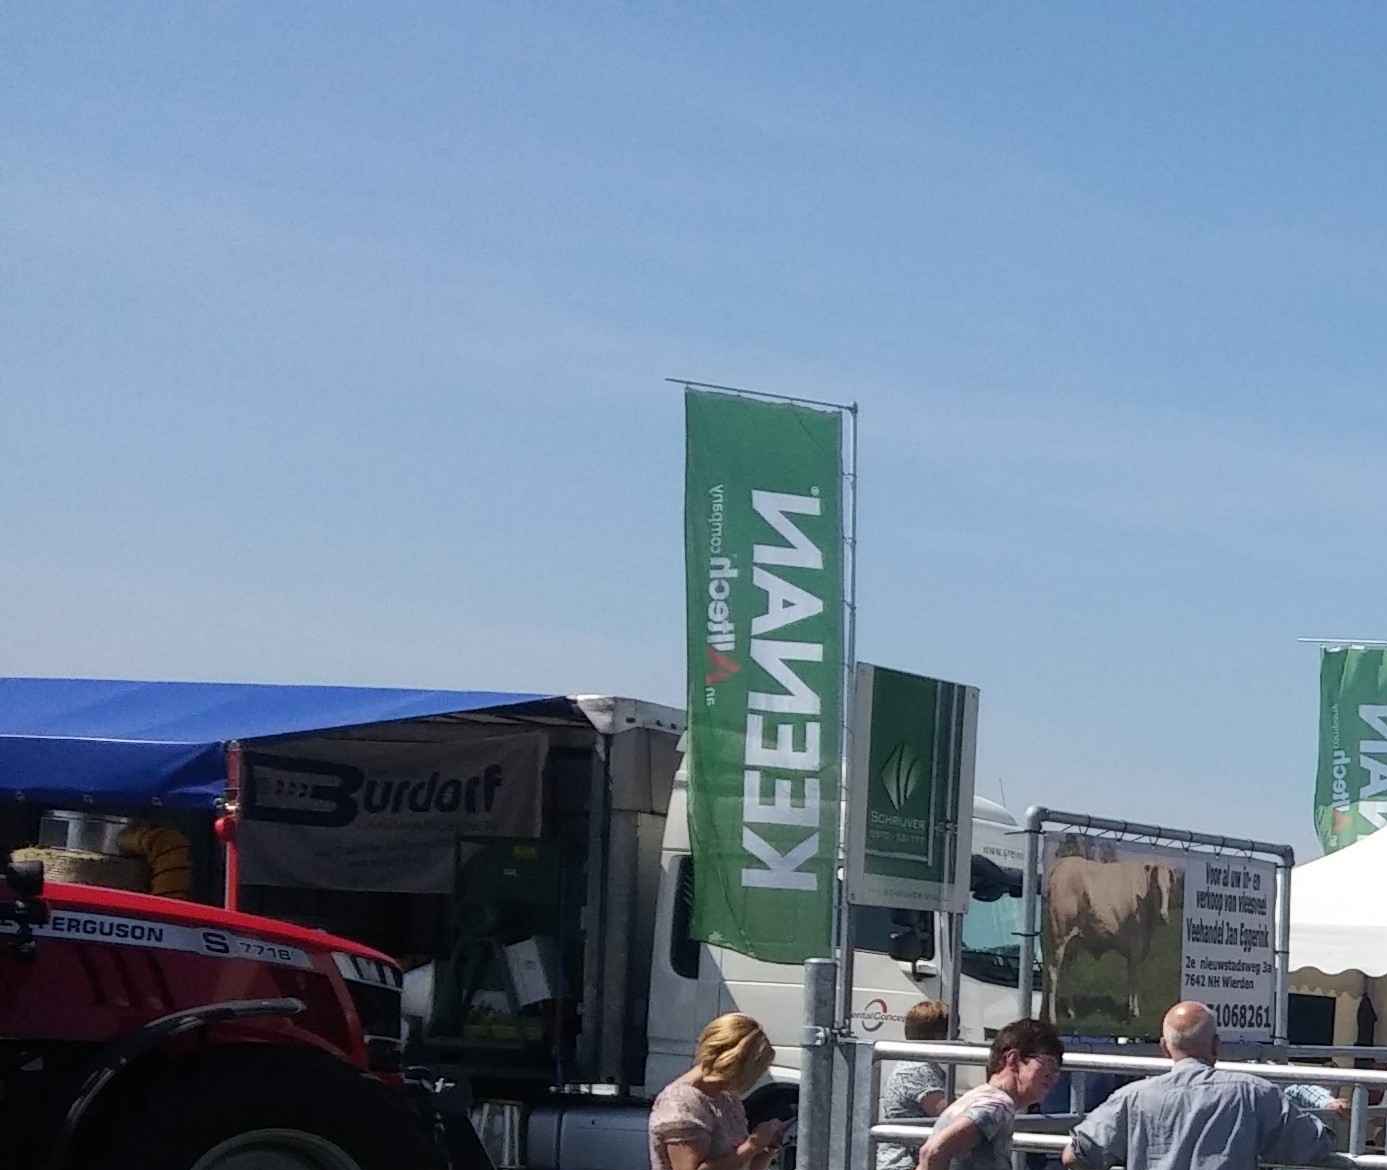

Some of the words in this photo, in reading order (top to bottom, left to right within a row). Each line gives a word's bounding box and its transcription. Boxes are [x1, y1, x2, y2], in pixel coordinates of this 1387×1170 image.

[1186, 917, 1224, 945] Veehandel
[1185, 956, 1196, 969] 2e
[1184, 974, 1206, 987] 7642
[1207, 975, 1220, 988] NH
[1221, 976, 1254, 989] Wierden
[1206, 1003, 1271, 1029] 1068261
